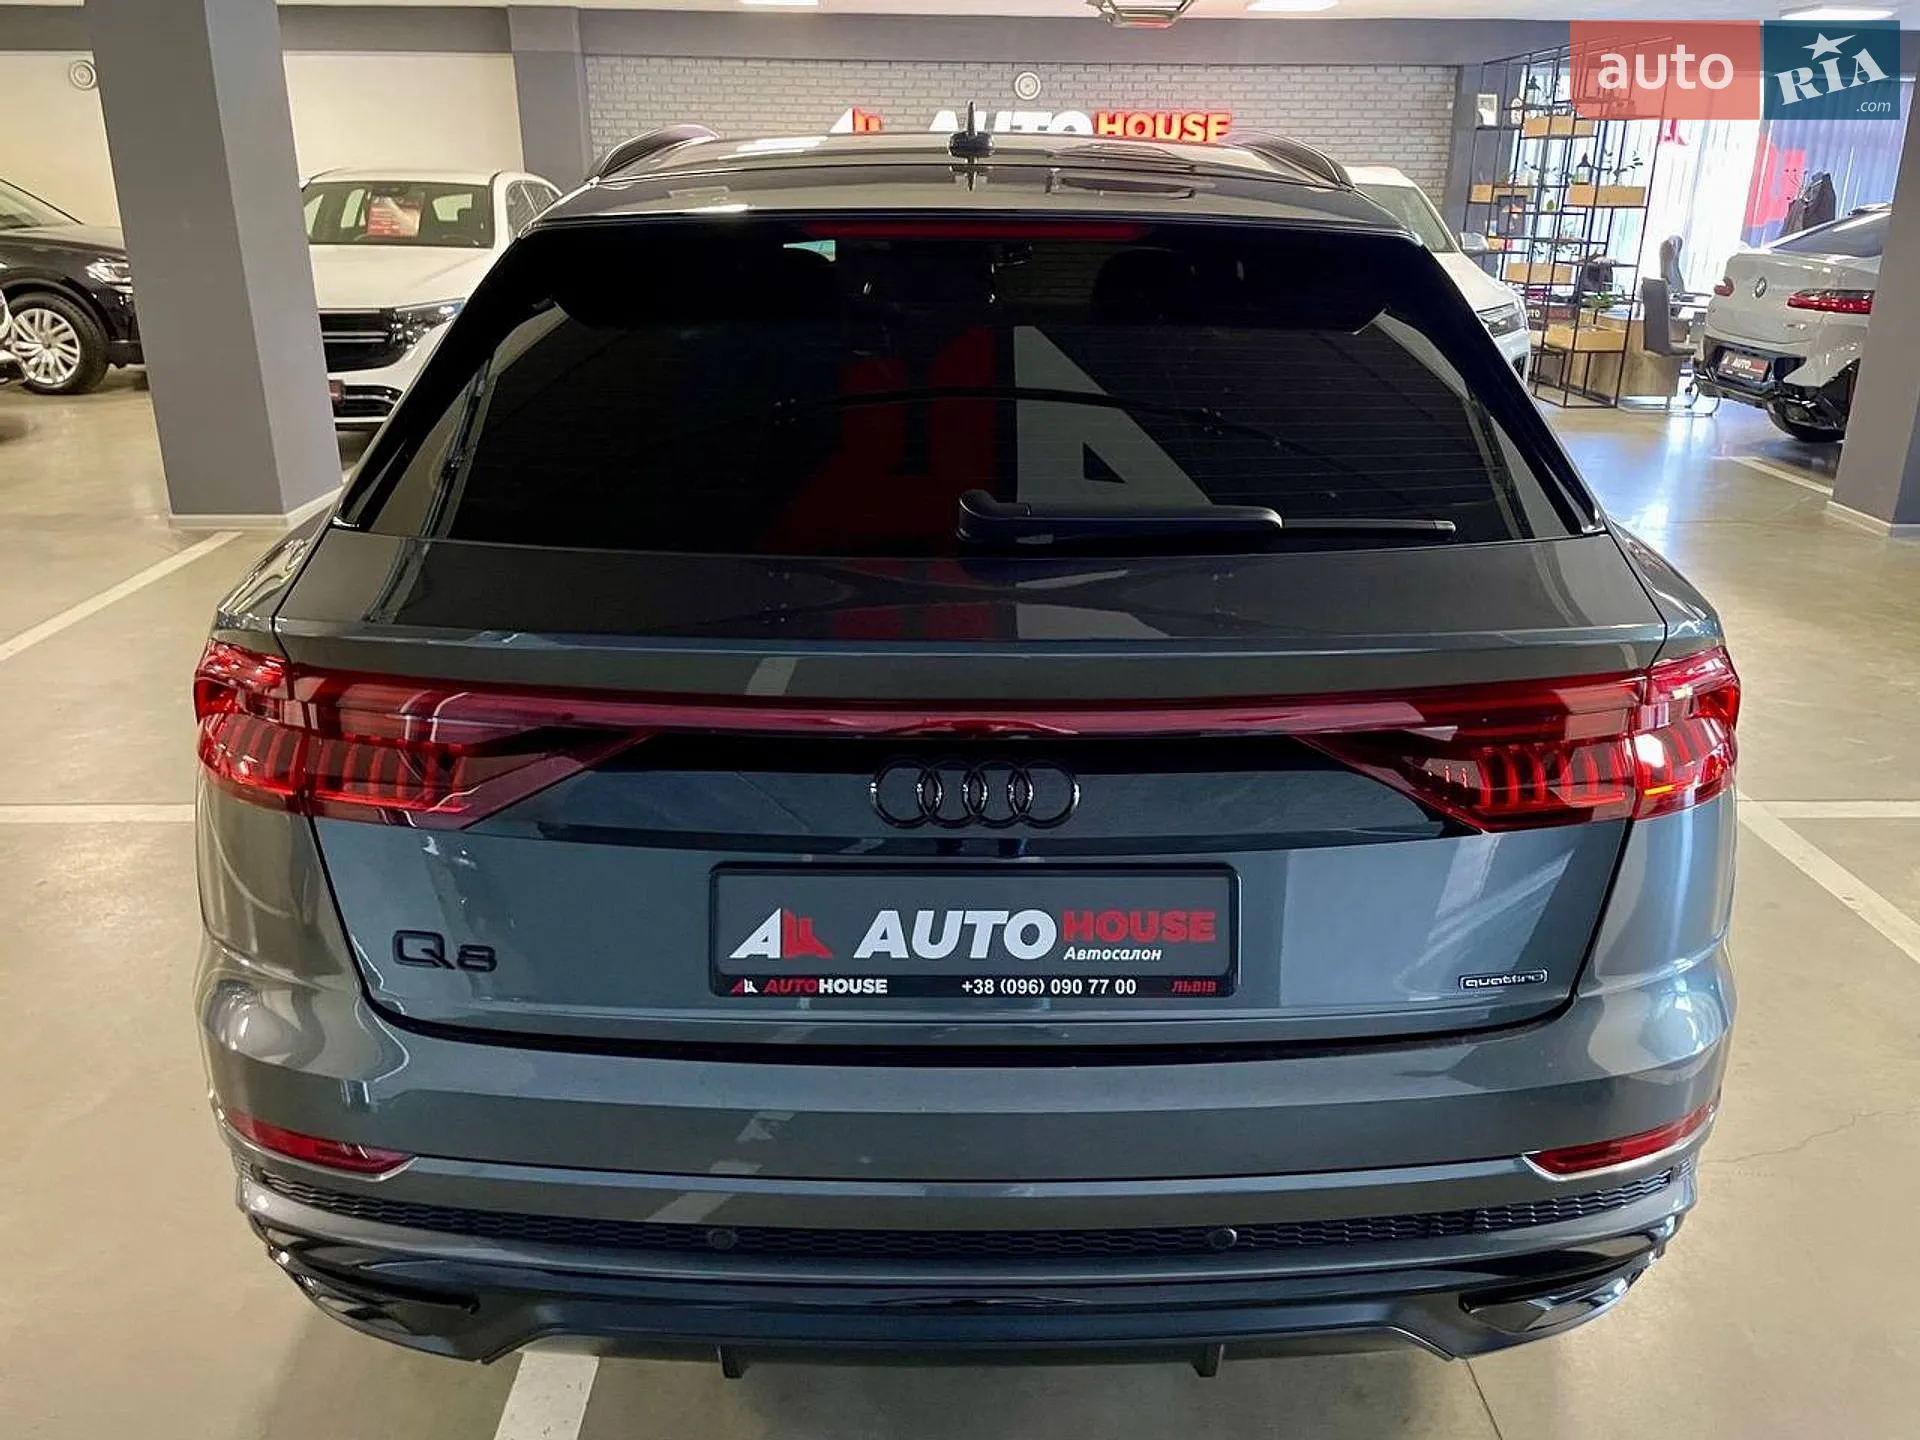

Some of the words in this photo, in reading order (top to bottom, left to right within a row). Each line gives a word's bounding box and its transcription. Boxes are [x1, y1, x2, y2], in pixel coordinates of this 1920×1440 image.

[1096, 111, 1231, 143] HOUSE
[853, 910, 1057, 960] AUTO
[1062, 909, 1216, 943] HOUSE
[392, 930, 498, 973] Q8
[1063, 946, 1162, 961] Автосалон
[961, 978, 995, 995] +38
[1000, 978, 1045, 995] (096)
[1050, 978, 1083, 995] 090
[1088, 978, 1110, 995] 77
[1115, 978, 1137, 995] 00
[1465, 974, 1543, 989] quattro
